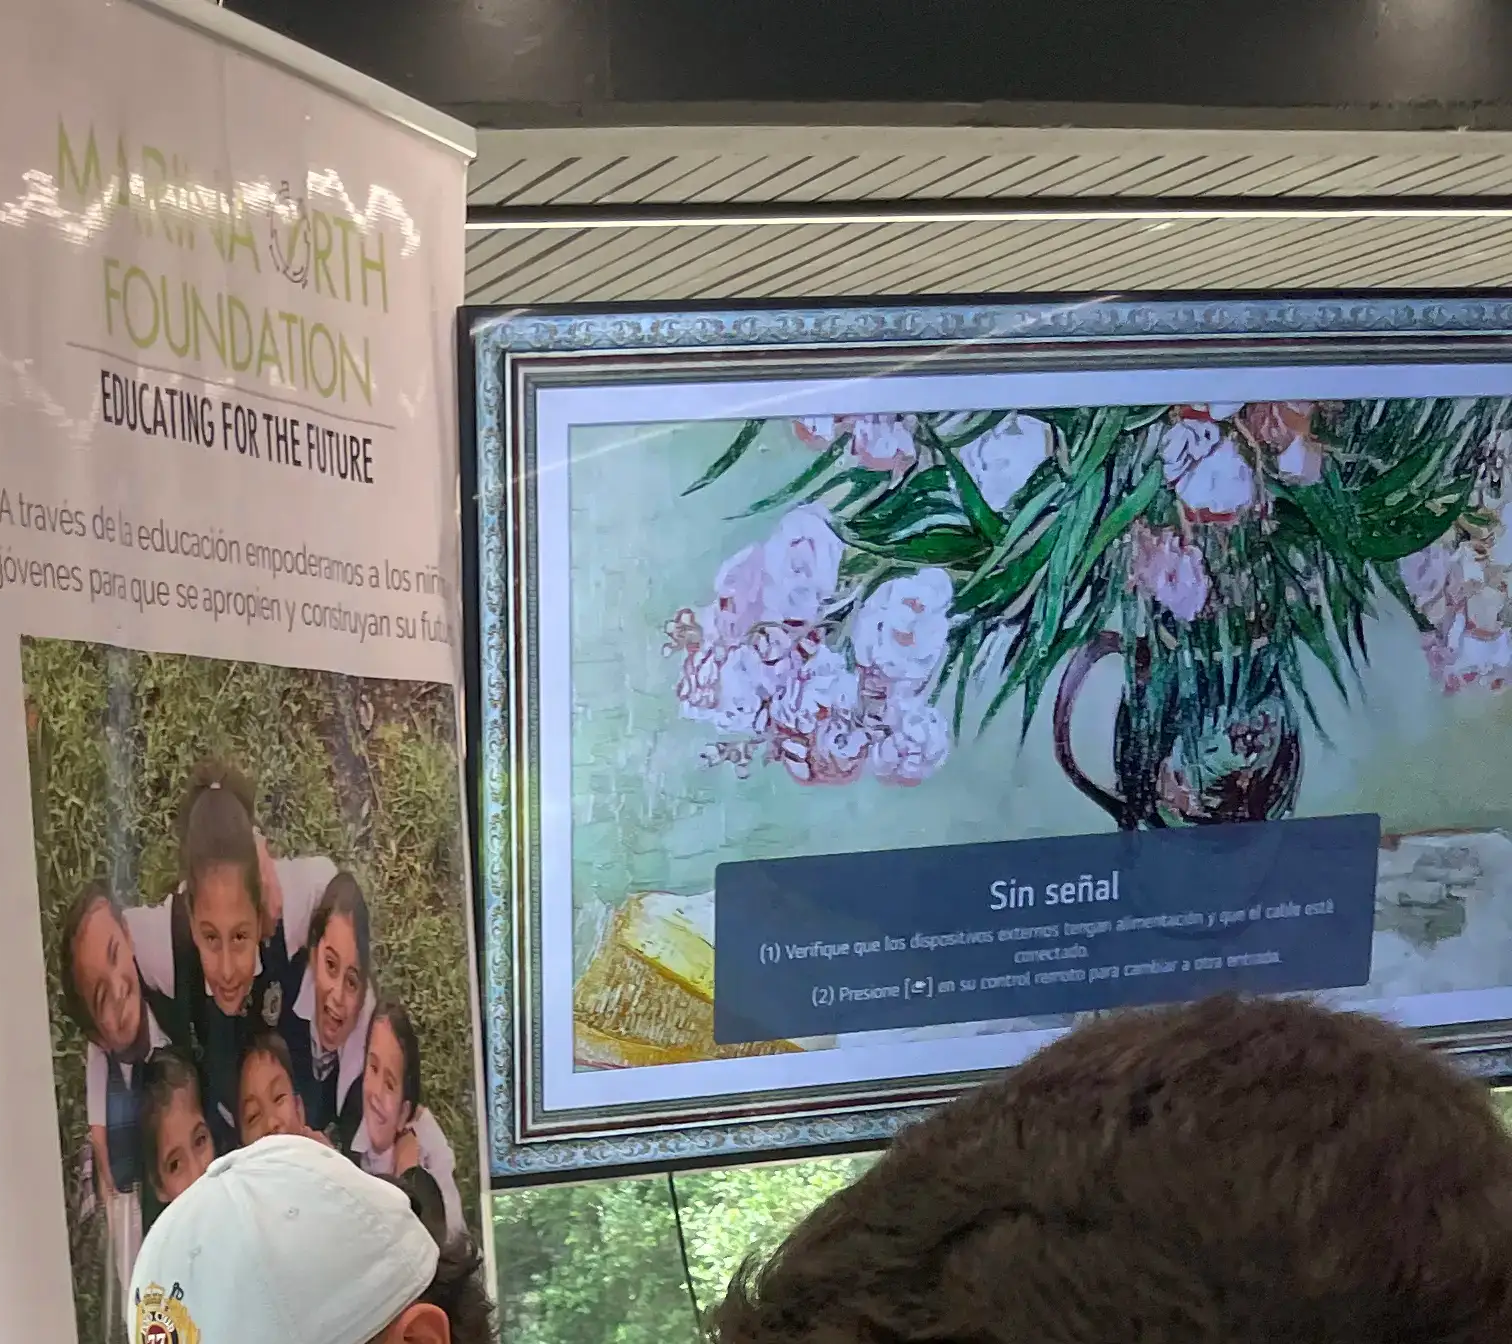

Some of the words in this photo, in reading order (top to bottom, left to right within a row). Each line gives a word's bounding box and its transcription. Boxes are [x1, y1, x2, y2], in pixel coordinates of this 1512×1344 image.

[103, 256, 373, 406] FOUNDATION
[101, 370, 215, 448] EDUCATING
[221, 401, 260, 458] FOR
[262, 413, 302, 467] THE
[306, 422, 374, 484] FUTURE
[18, 492, 86, 537] través
[92, 505, 115, 543] de
[119, 509, 133, 547] la
[138, 518, 240, 563] educación
[246, 540, 364, 587] empoderamos
[368, 565, 380, 588] a
[384, 559, 411, 592] los
[89, 568, 126, 602] para
[130, 576, 170, 613] que
[175, 582, 198, 610] se
[202, 586, 281, 626] apropien
[285, 601, 296, 632] y
[301, 602, 391, 643] construyan
[396, 615, 417, 640] su
[989, 878, 1034, 911] Sin
[1045, 870, 1119, 905] señal
[759, 942, 781, 965] (1)
[785, 940, 850, 961] Verifique
[853, 939, 880, 958] que
[884, 934, 906, 952] los
[910, 929, 994, 951] dispositivos
[1219, 908, 1246, 928] que
[811, 985, 835, 1007] (2)
[839, 984, 900, 1002] Presione
[938, 980, 955, 993] en
[960, 978, 976, 992] su
[980, 970, 1030, 989] control
